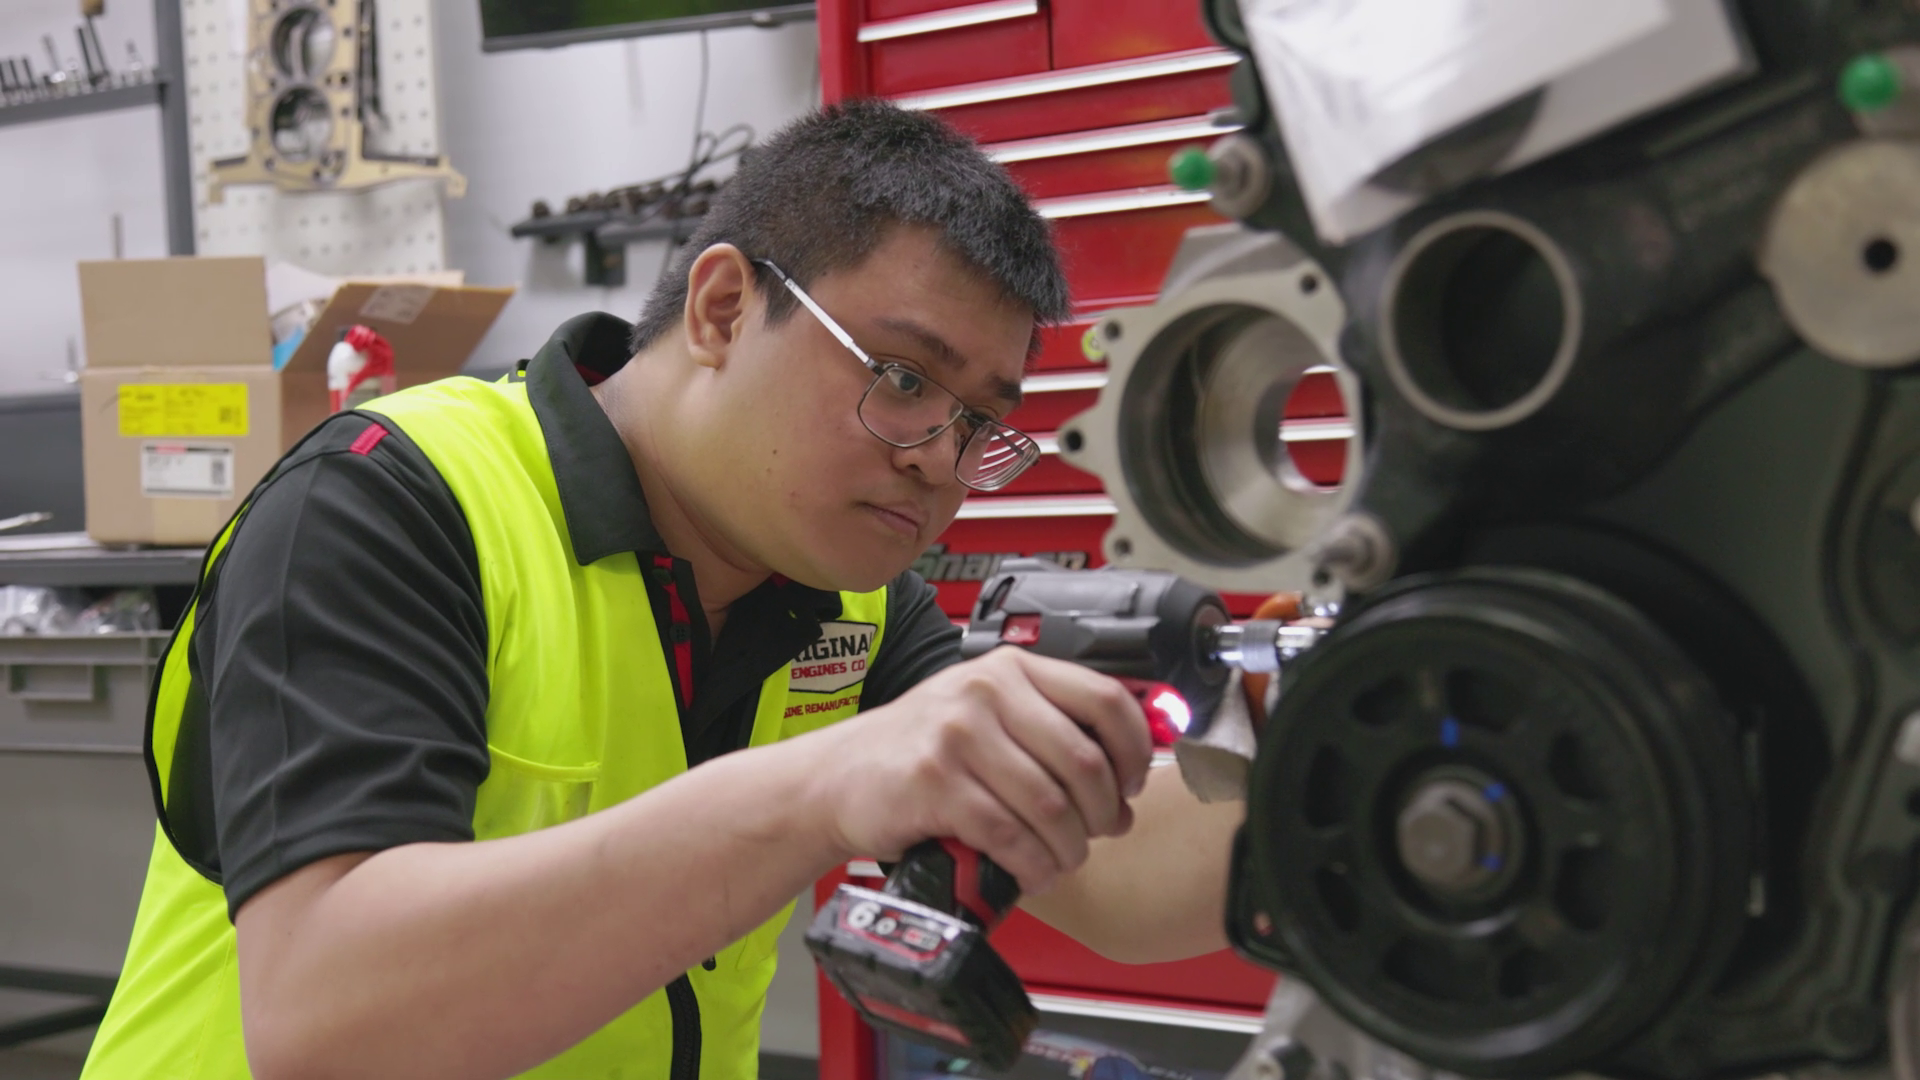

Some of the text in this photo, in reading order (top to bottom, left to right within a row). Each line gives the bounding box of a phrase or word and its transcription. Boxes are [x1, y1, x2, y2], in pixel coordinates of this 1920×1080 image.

[911, 543, 1087, 581] Snan
[795, 632, 872, 662] IGINA
[791, 662, 847, 679] ENGINES
